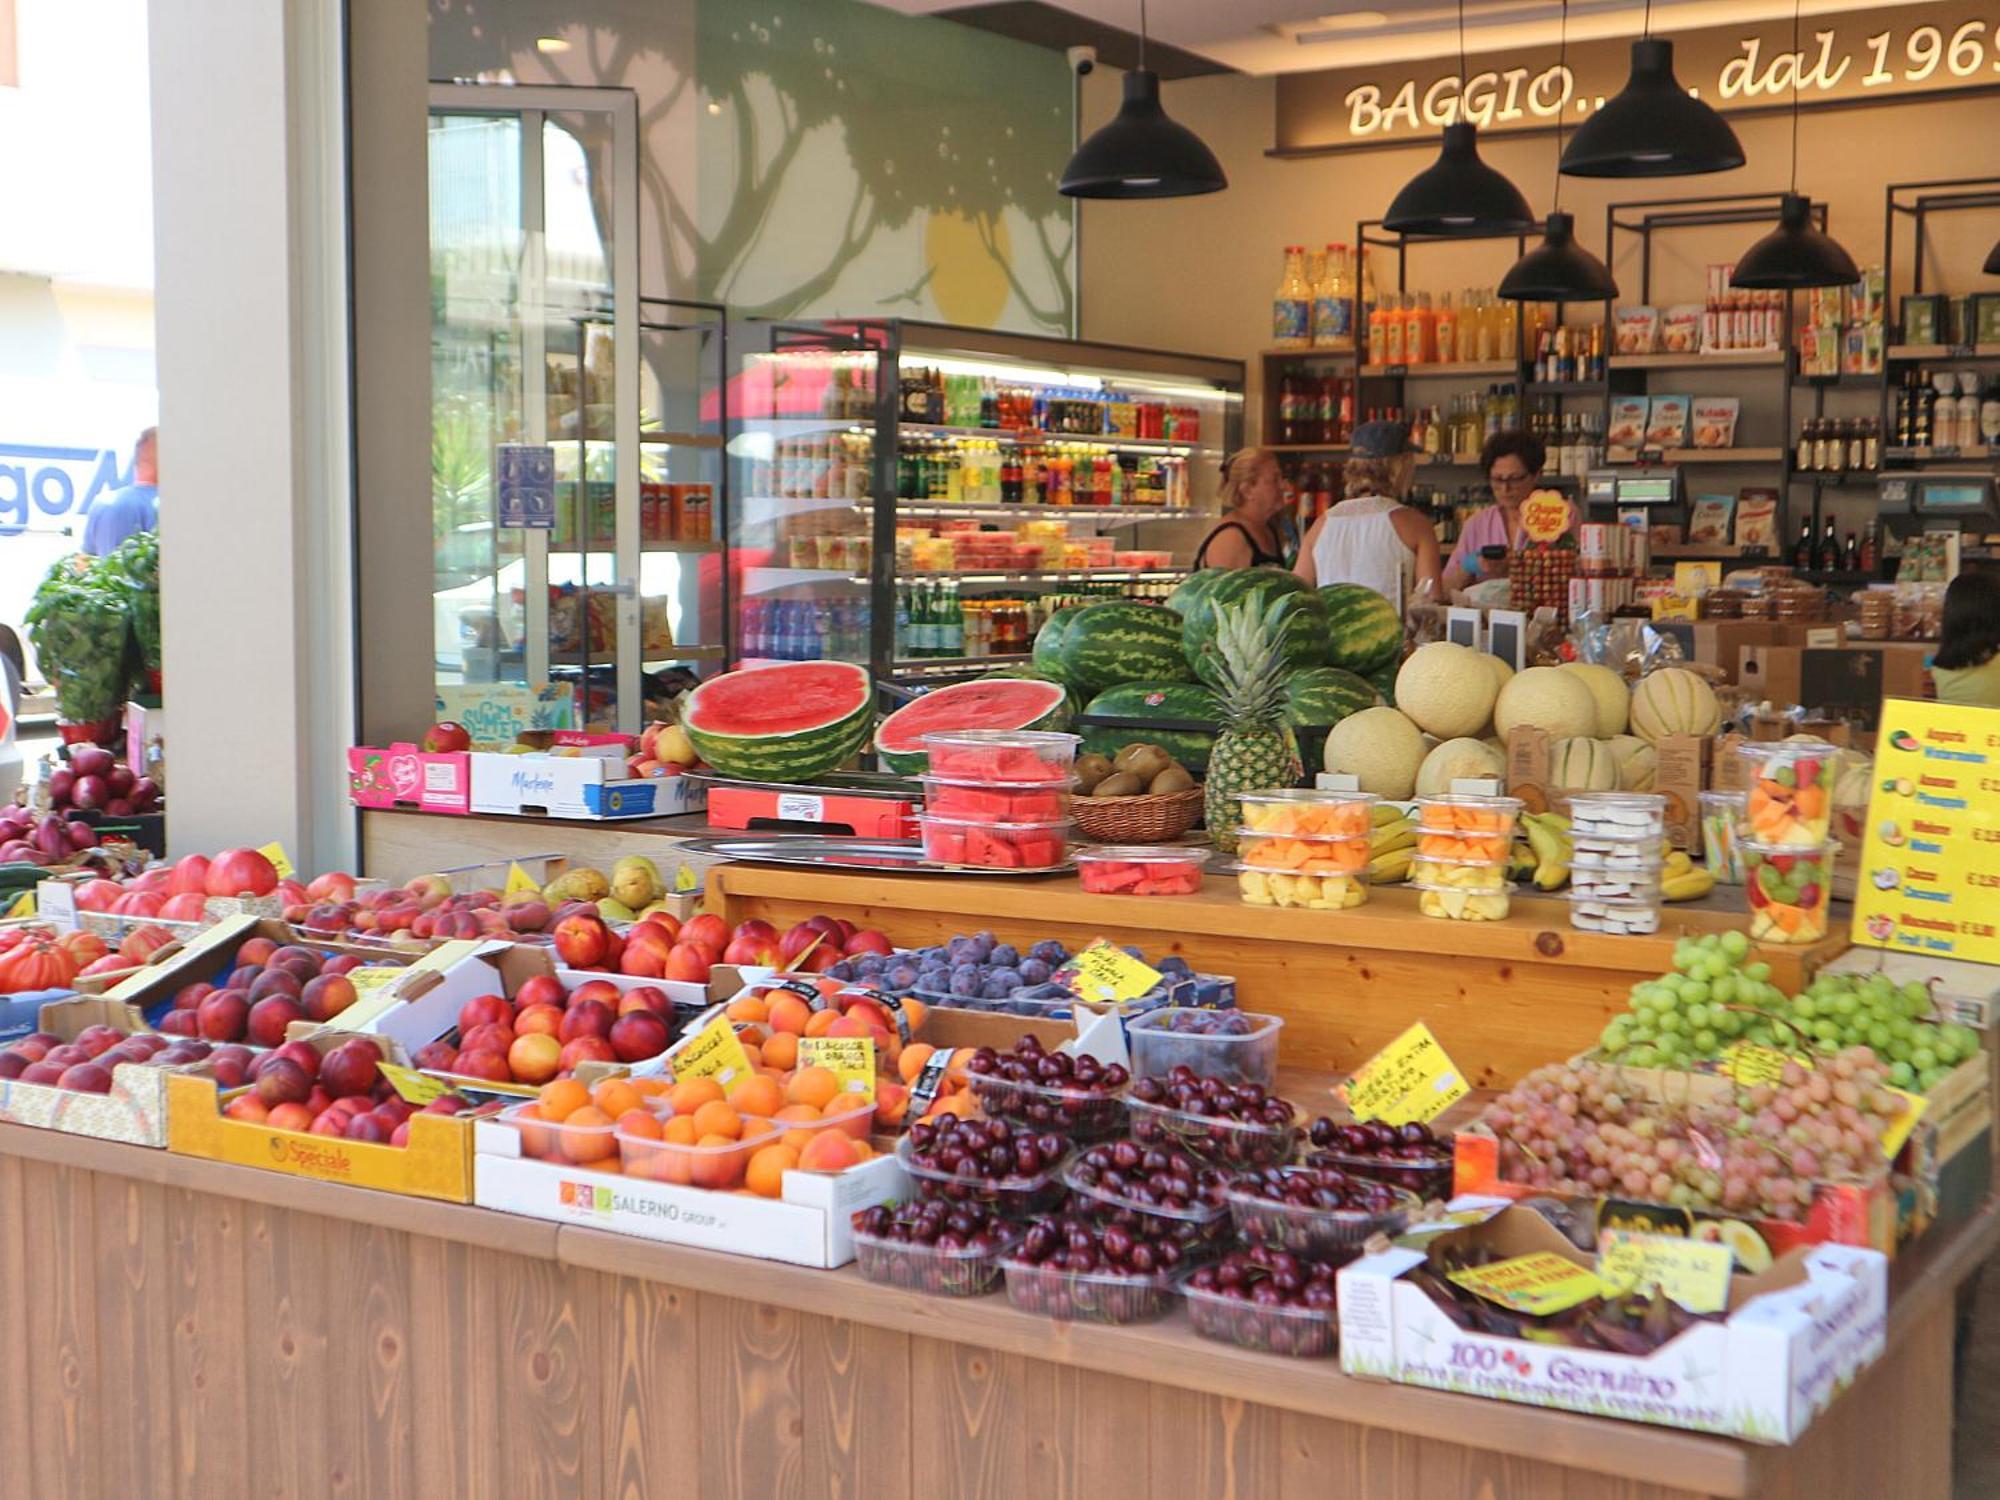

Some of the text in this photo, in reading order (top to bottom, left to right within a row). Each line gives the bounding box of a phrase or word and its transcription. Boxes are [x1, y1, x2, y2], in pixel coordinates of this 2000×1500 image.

[1718, 31, 1851, 98] dal
[1862, 21, 2000, 87] 196
[612, 1195, 680, 1221] SALERNO
[1547, 1357, 1677, 1400] Genuino
